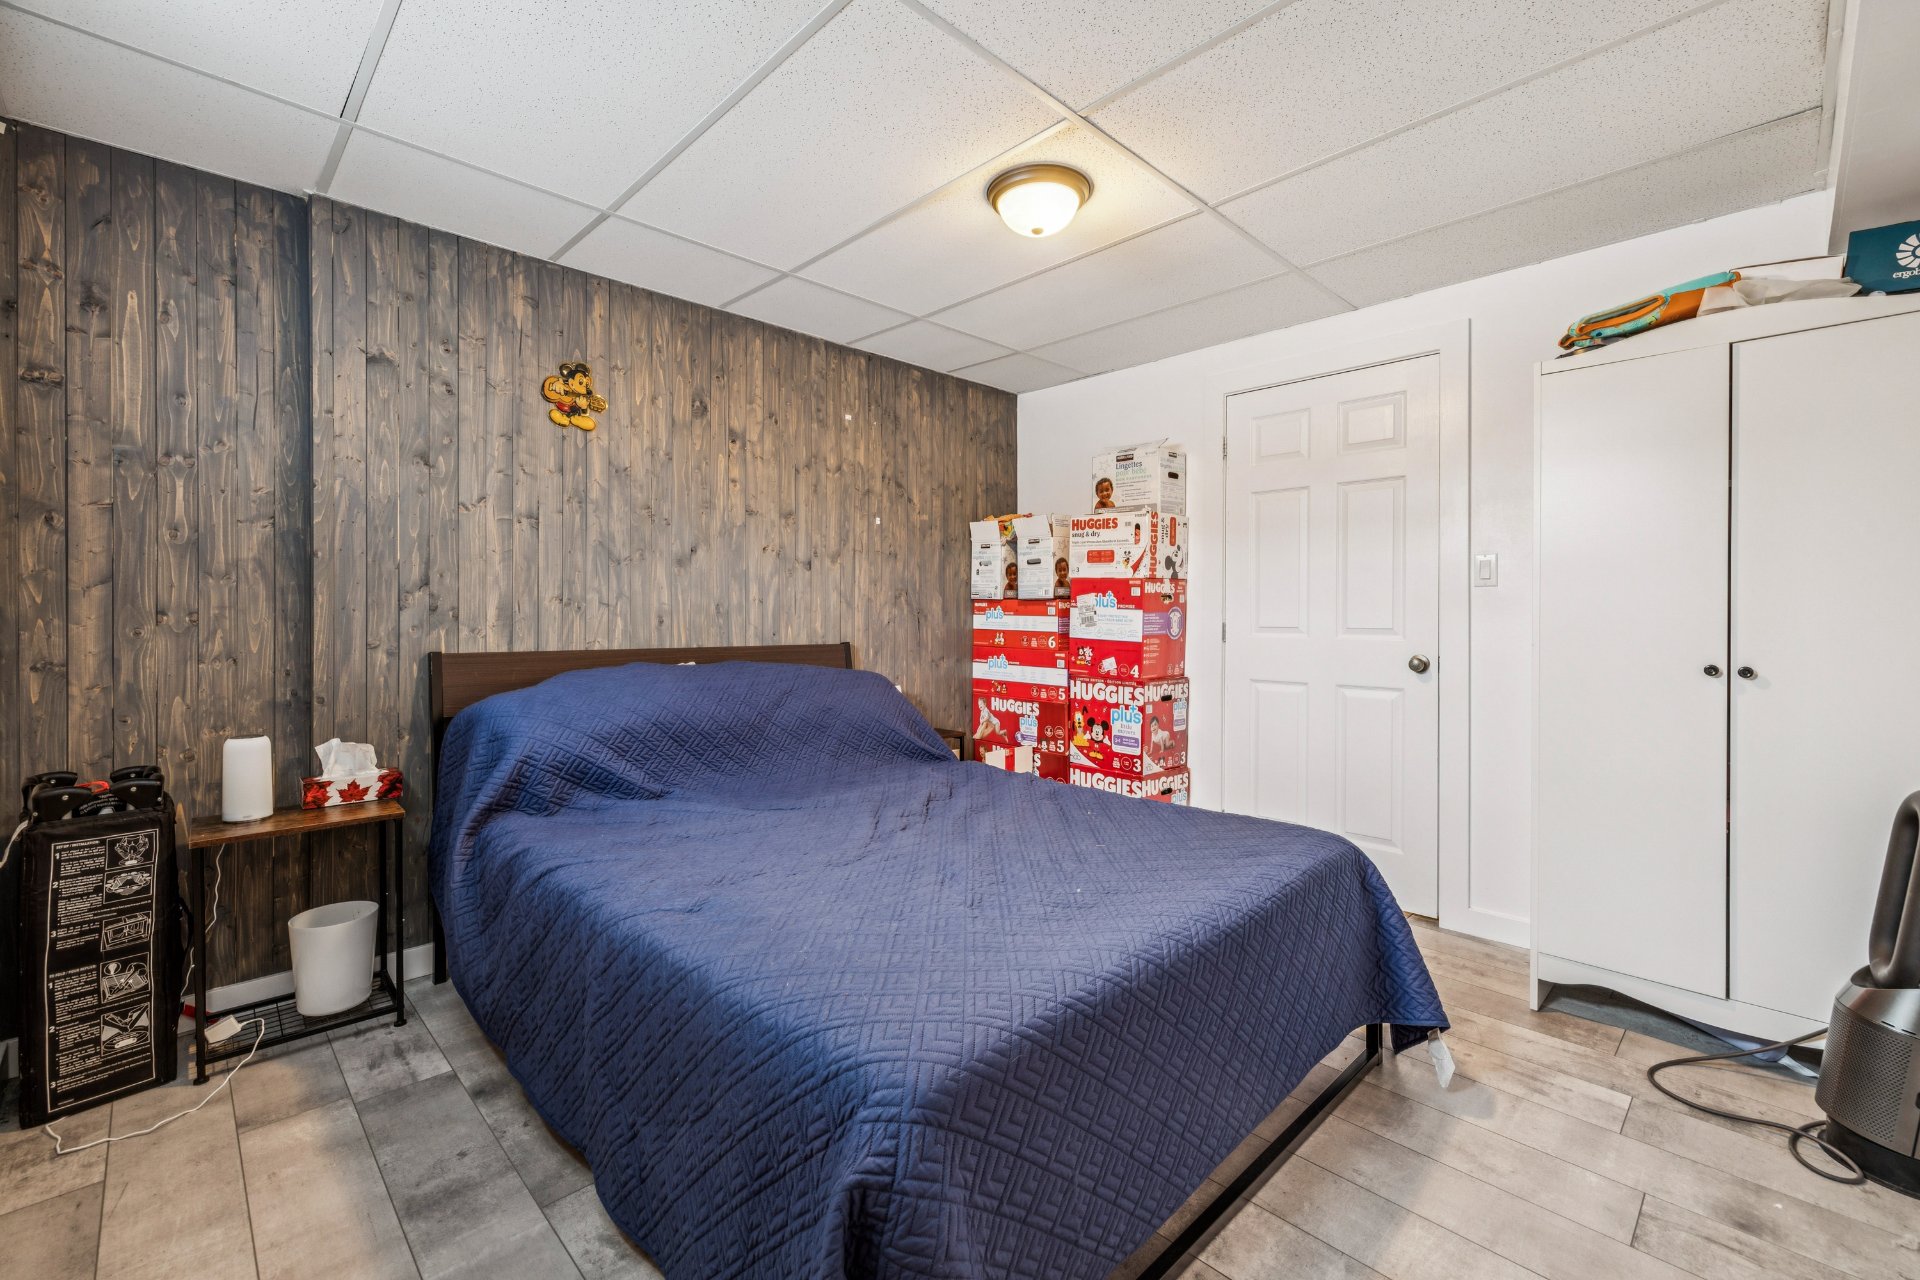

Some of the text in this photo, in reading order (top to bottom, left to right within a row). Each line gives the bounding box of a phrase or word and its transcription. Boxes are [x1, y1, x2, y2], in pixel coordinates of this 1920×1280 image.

[1115, 461, 1143, 470] Lingettes
[1071, 518, 1118, 531] HUGGIES
[1090, 530, 1100, 538] dry
[1149, 511, 1159, 578] HUGGIES
[985, 605, 1004, 621] plus
[1048, 636, 1056, 649] 6
[988, 653, 1008, 670] plus
[1130, 665, 1139, 678] 4
[1058, 688, 1066, 700] 5
[1069, 680, 1145, 706] HUGGIES
[1144, 682, 1189, 702] HUGGIES
[991, 697, 1040, 716] HUGGIES
[1174, 698, 1187, 711] plus
[1020, 714, 1038, 727] plus
[1111, 704, 1142, 724] plus
[1057, 740, 1065, 752] 5
[1180, 752, 1186, 764] 3
[1133, 759, 1141, 772] 3
[1069, 768, 1142, 799] HUGGIES
[1142, 772, 1189, 797] HUGGIES
[50, 930, 57, 938] 3
[50, 1081, 56, 1089] 3
